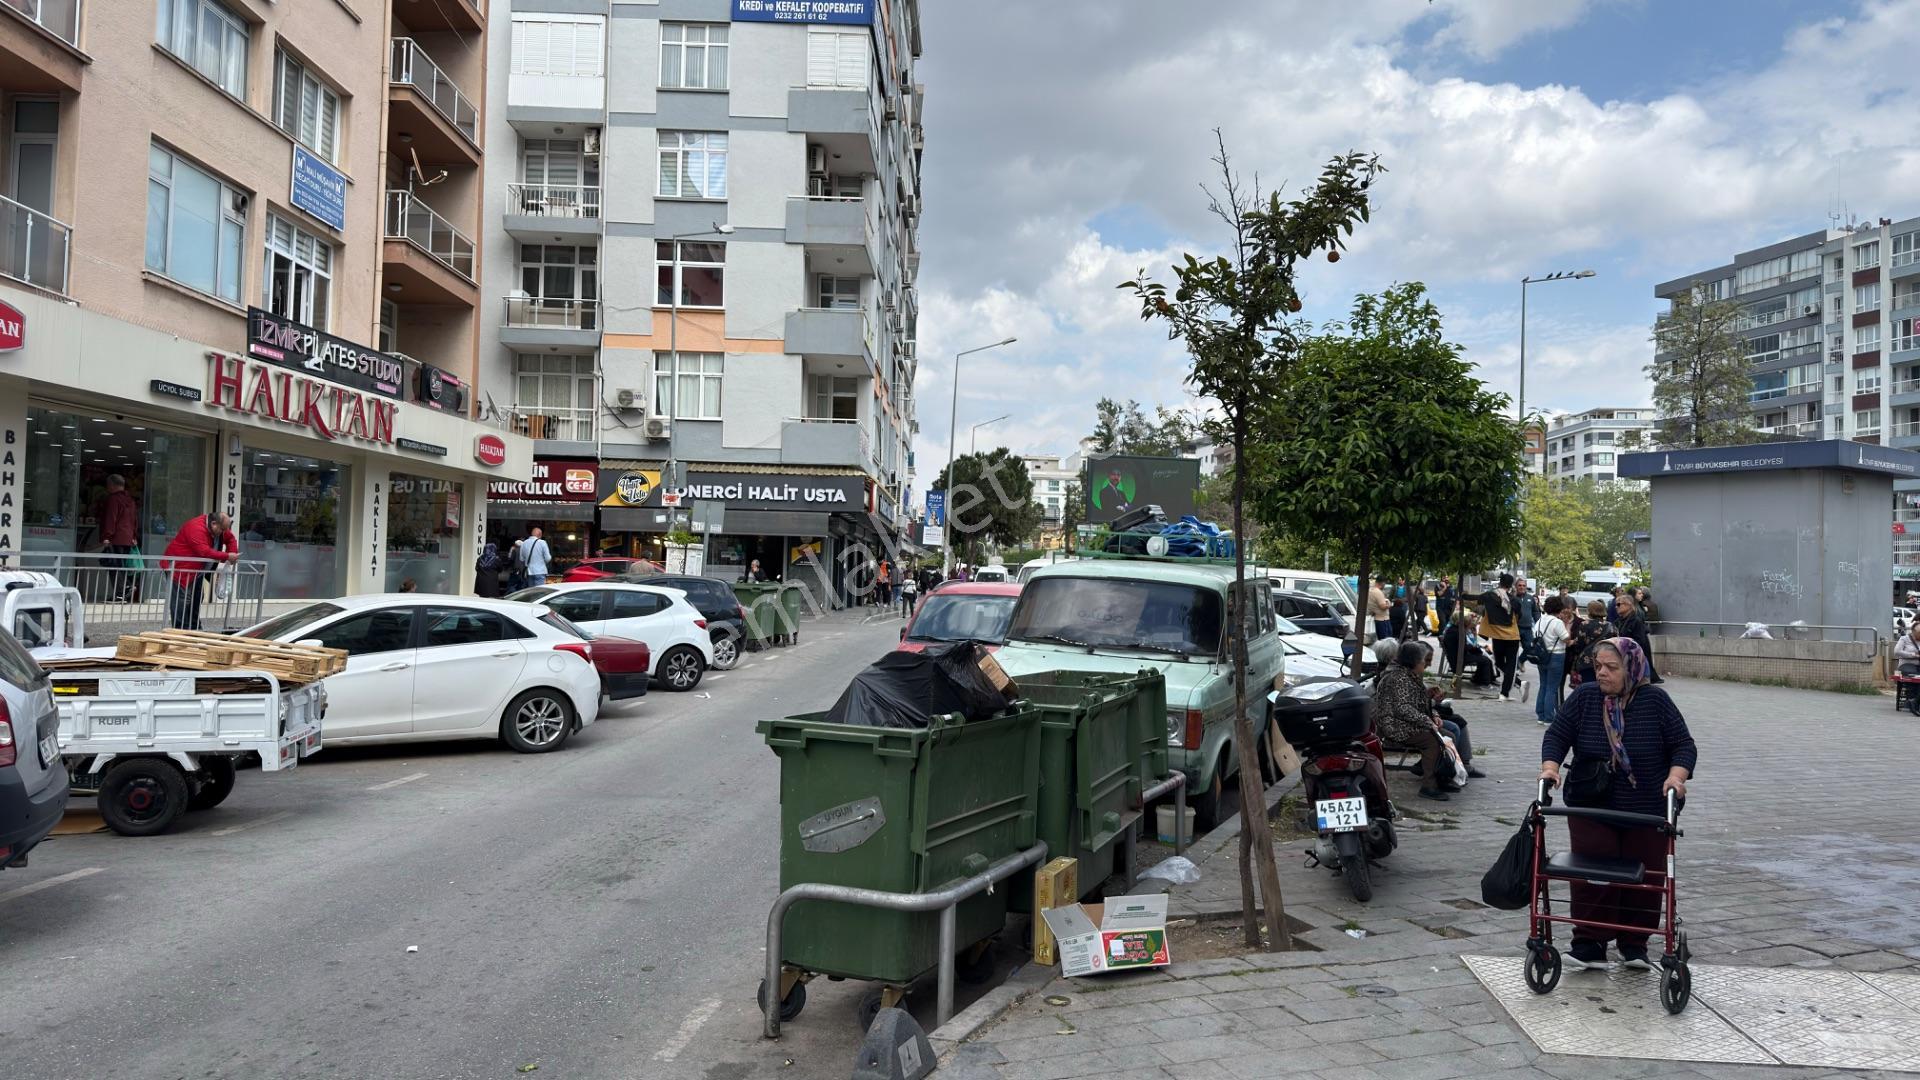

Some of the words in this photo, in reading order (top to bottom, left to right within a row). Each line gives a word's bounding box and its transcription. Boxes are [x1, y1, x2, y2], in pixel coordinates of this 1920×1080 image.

[775, 2, 810, 12] KEFALET
[259, 313, 301, 353] İZMİR
[303, 331, 357, 370] PİLATES
[358, 353, 401, 385] STUDIO
[209, 352, 397, 446] HALKTAN
[480, 443, 504, 457] HALKTAN
[0, 430, 15, 566] BAHARAT
[748, 484, 799, 501] HALİT
[804, 488, 847, 502] USTA
[371, 483, 380, 577] BAKLİYAT
[98, 717, 130, 726] KUBA
[1335, 813, 1359, 825] 121
